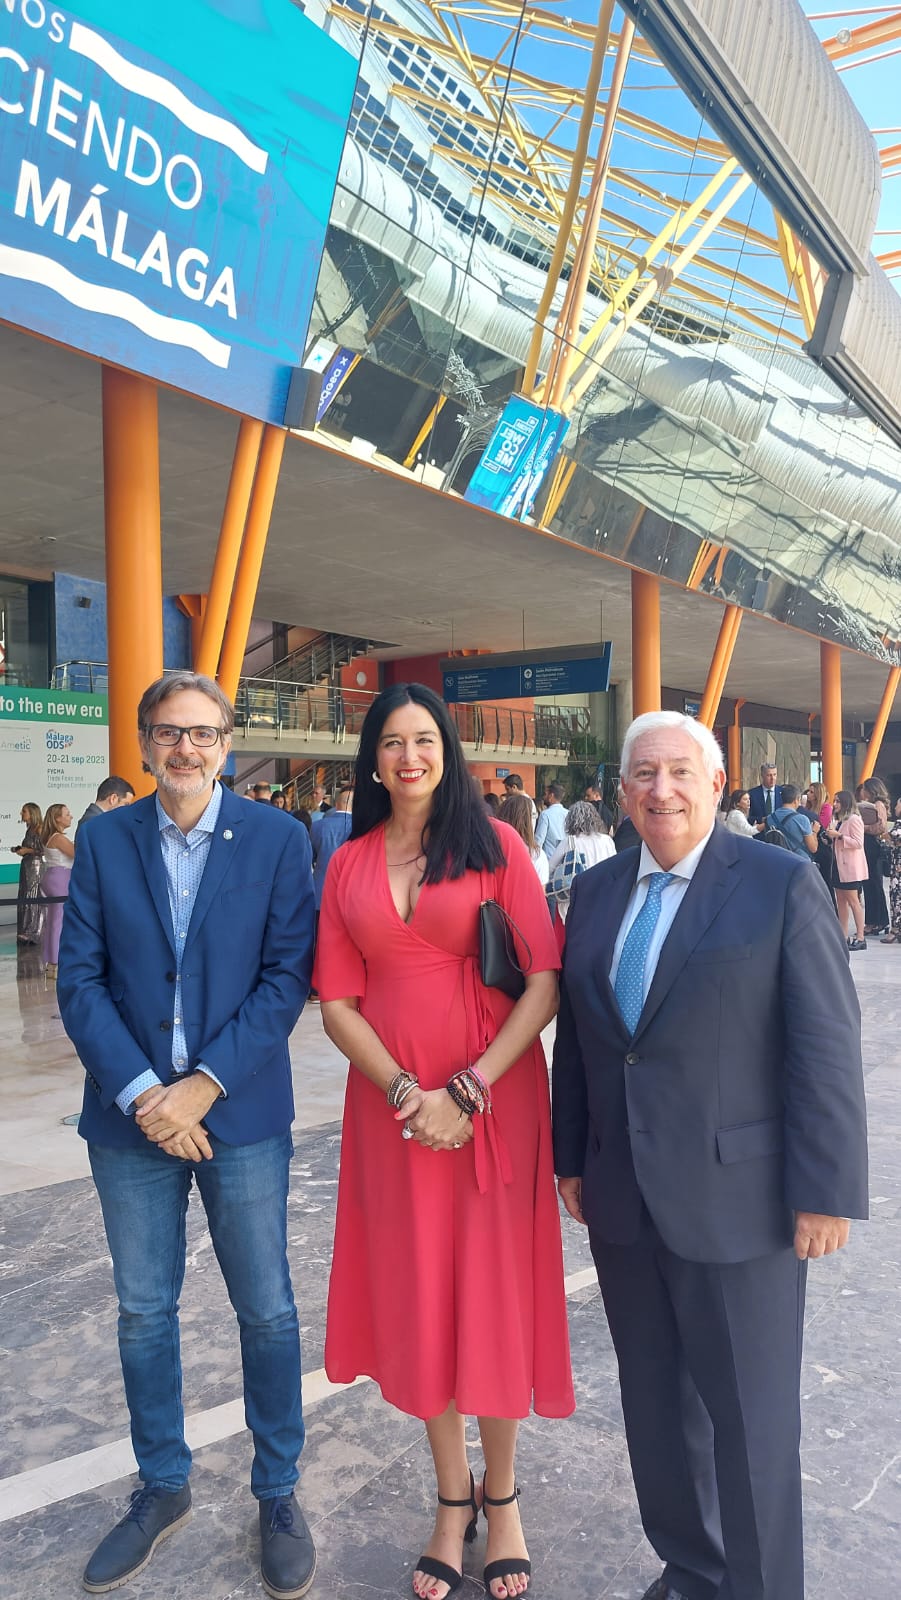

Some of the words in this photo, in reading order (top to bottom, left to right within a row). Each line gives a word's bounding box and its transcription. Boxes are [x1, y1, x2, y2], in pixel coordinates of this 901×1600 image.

[0, 46, 203, 210] CIENDO
[14, 159, 238, 320] MÁLAGA
[0, 695, 15, 712] to
[18, 696, 43, 714] the
[47, 702, 77, 716] new
[80, 704, 103, 718] era
[46, 731, 74, 743] Málaga
[46, 740, 65, 750] ODS
[47, 753, 70, 763] 20-21
[71, 755, 85, 765] sep
[86, 755, 105, 764] 2023
